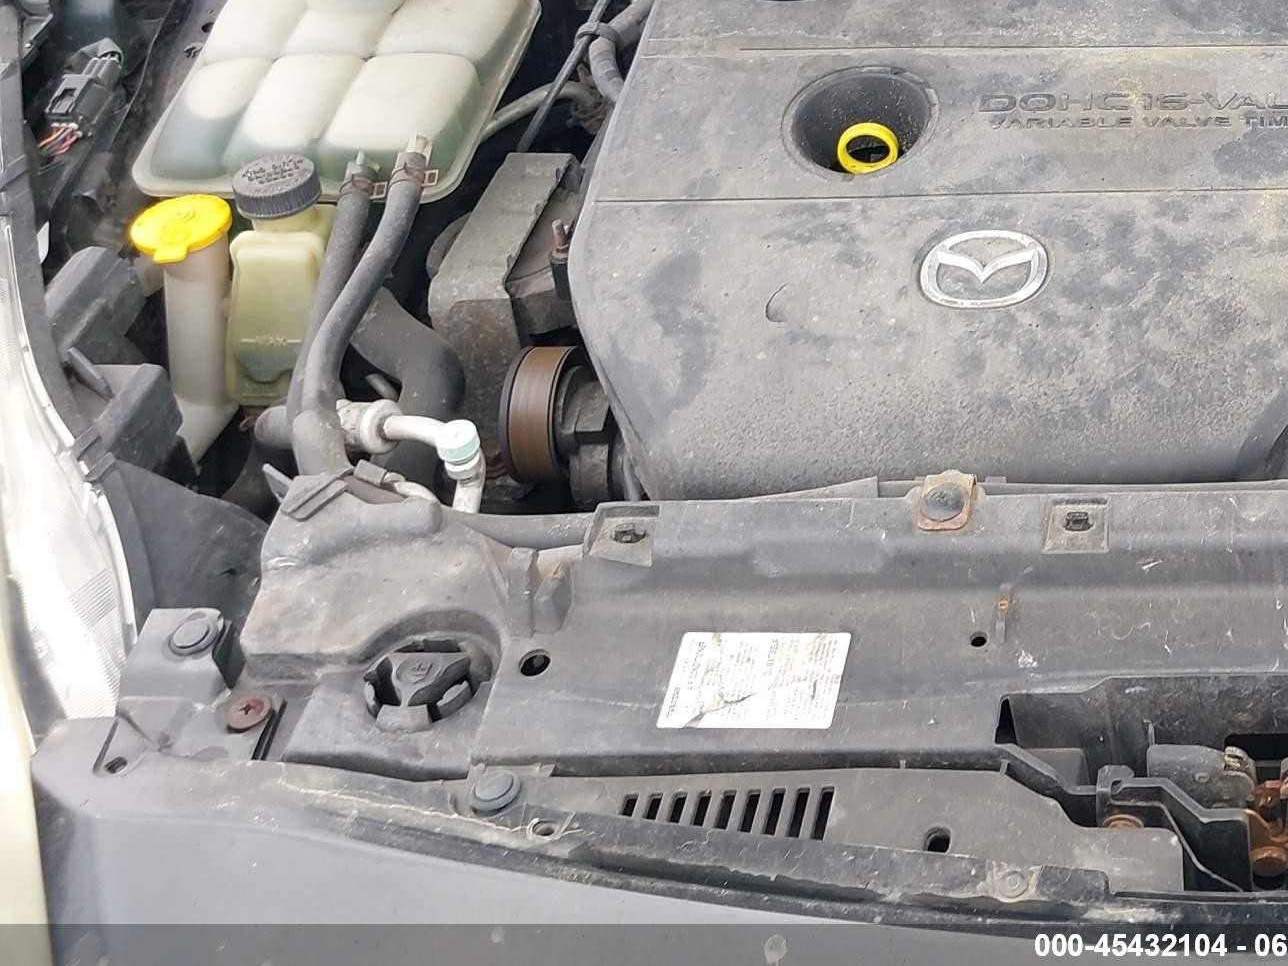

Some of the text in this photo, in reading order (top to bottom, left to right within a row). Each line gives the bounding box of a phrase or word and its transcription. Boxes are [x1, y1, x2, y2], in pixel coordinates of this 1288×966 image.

[978, 92, 1130, 113] DOHC
[990, 116, 1132, 129] VARIABLE
[1142, 115, 1232, 128] VALVE
